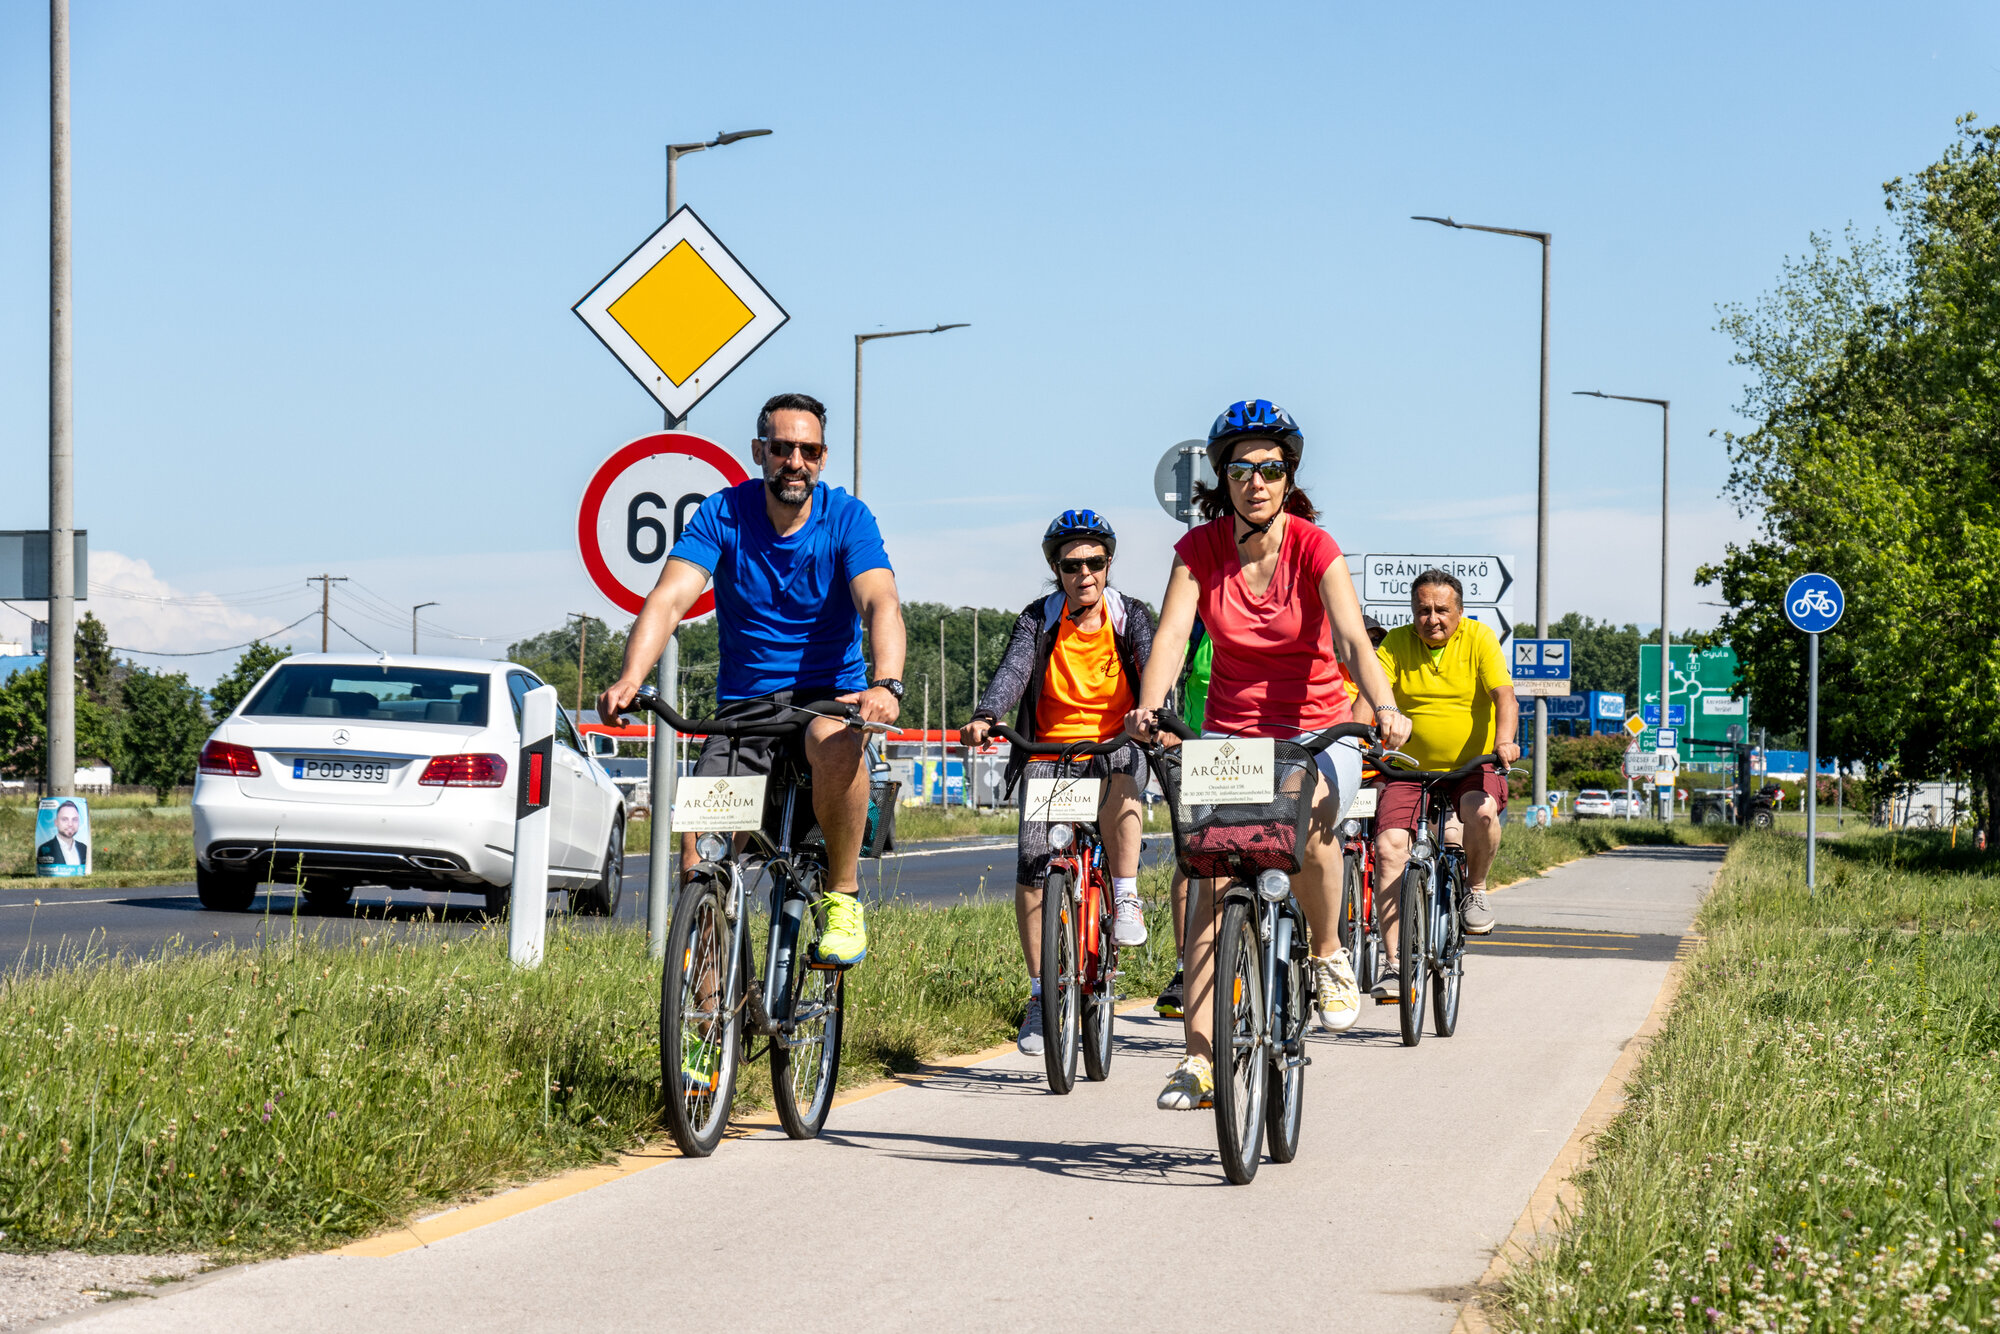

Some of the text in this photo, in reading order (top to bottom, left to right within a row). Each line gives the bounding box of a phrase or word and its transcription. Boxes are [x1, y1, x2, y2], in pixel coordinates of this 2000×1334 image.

[1374, 560, 1432, 576] GRÁNIT
[1702, 650, 1729, 659] Gyula
[306, 762, 385, 780] POD-999
[1190, 765, 1264, 777] ARCANUM
[683, 798, 754, 808] ARCANUM
